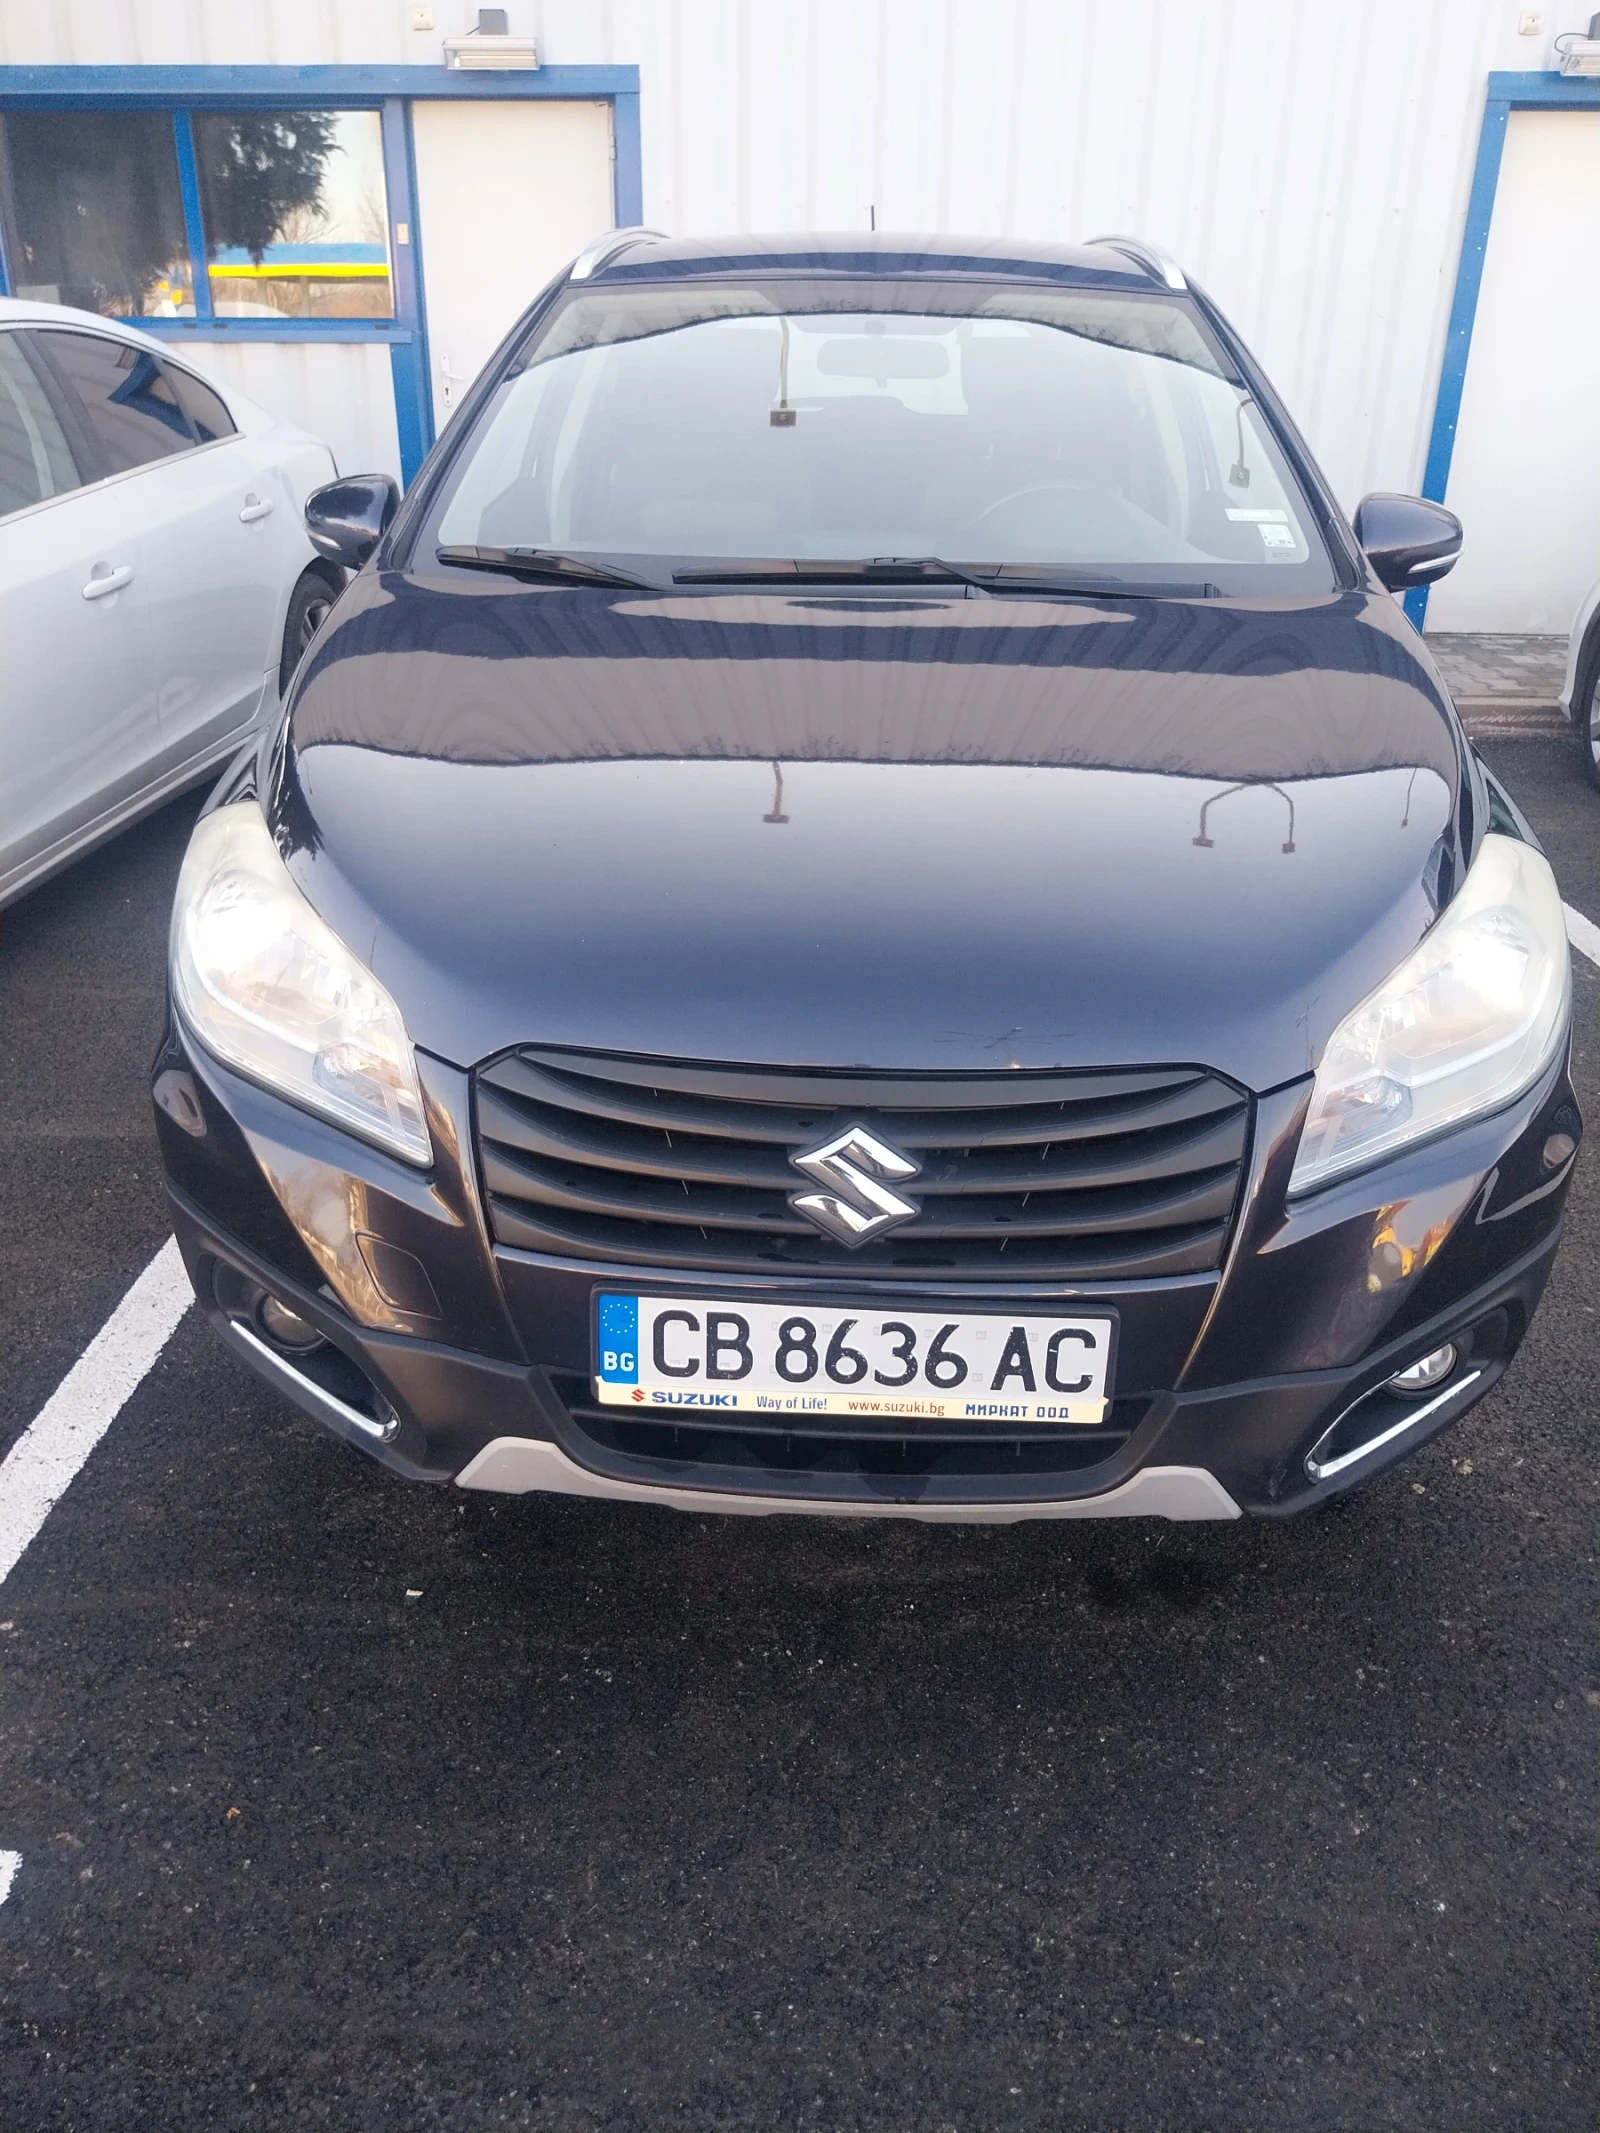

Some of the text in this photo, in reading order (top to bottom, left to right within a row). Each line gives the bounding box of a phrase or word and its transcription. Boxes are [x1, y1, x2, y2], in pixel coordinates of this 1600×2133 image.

[652, 1309, 1097, 1393] CB 8636 AC
[604, 1351, 635, 1372] BG
[651, 1391, 738, 1407] SUZUKI
[756, 1395, 828, 1411] Way of Life!
[848, 1400, 946, 1417] www.suzuki.bg
[1036, 1406, 1070, 1419] ООД
